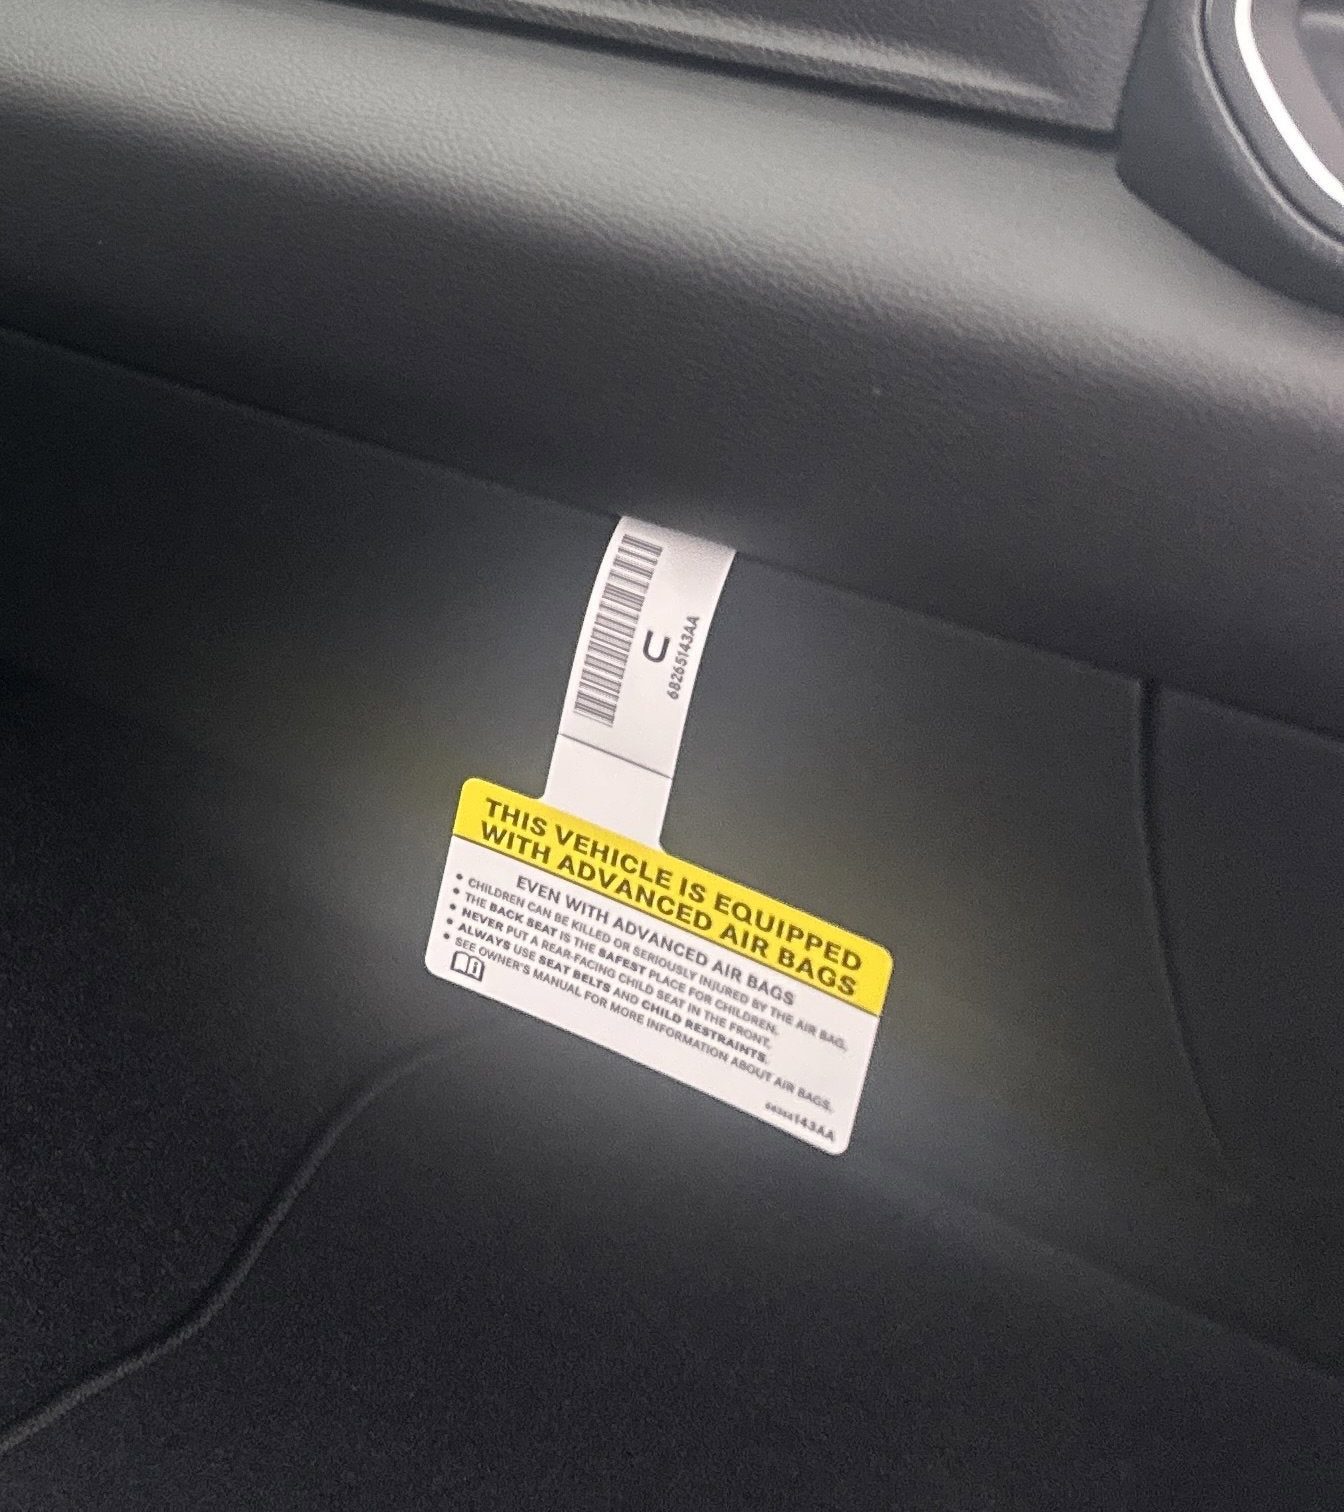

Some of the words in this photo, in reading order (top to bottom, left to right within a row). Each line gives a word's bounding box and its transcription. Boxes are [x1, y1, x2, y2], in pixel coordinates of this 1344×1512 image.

[643, 630, 671, 663] U
[666, 615, 701, 700] 68265143AA
[463, 890, 487, 909] THE
[489, 901, 524, 924] BACK
[526, 916, 557, 938] SEAT
[559, 930, 571, 944] IS
[572, 935, 596, 954] THE
[597, 946, 647, 976] SAFEST
[647, 968, 686, 993] PLACE
[687, 985, 713, 1005] FOR
[478, 819, 551, 865] WITH
[556, 851, 714, 933] ADVANCED
[718, 920, 770, 958] AIR
[776, 946, 857, 997] BAGS
[482, 796, 548, 839] THIS
[552, 824, 673, 890] VEHICLE
[678, 876, 707, 905] IS
[713, 891, 863, 973] EQUIPPED
[515, 873, 561, 905] EVEN
[563, 893, 609, 925] WITH
[611, 913, 709, 968] ADVANCED
[711, 957, 742, 983] AIR
[745, 973, 796, 1006] BAGS
[454, 934, 477, 954] SEE
[477, 944, 531, 977] OWNER'S
[532, 967, 583, 998] MANUAL
[583, 989, 608, 1009] FOR
[609, 1001, 645, 1025] MORE
[645, 1017, 729, 1063] INFORMATION
[729, 1055, 772, 1082] ABOUT
[773, 1075, 795, 1094] AIR
[457, 920, 510, 952] ALWAYS
[512, 943, 536, 962] USE
[537, 953, 571, 976] SEAT
[571, 968, 611, 994] BELTS
[612, 985, 639, 1006] AND
[640, 998, 682, 1025] CHILD
[461, 906, 504, 932] NEVER
[505, 924, 529, 942] PUT
[529, 934, 539, 947] A
[540, 938, 616, 980] REAR-FACING
[617, 971, 655, 996] CHILD
[655, 988, 686, 1010] SEAT
[686, 1002, 701, 1017] IN
[703, 1009, 727, 1029] THE
[466, 875, 525, 909] CHILDREN
[526, 900, 552, 920] CAN
[553, 911, 569, 927] BE
[570, 919, 611, 945] KILLED
[612, 937, 630, 953] OR
[631, 944, 697, 982] SERIOUSLY
[698, 974, 749, 1005] INJURED
[751, 997, 767, 1013] BY
[768, 1005, 794, 1025] THE
[795, 1017, 817, 1036] AIR
